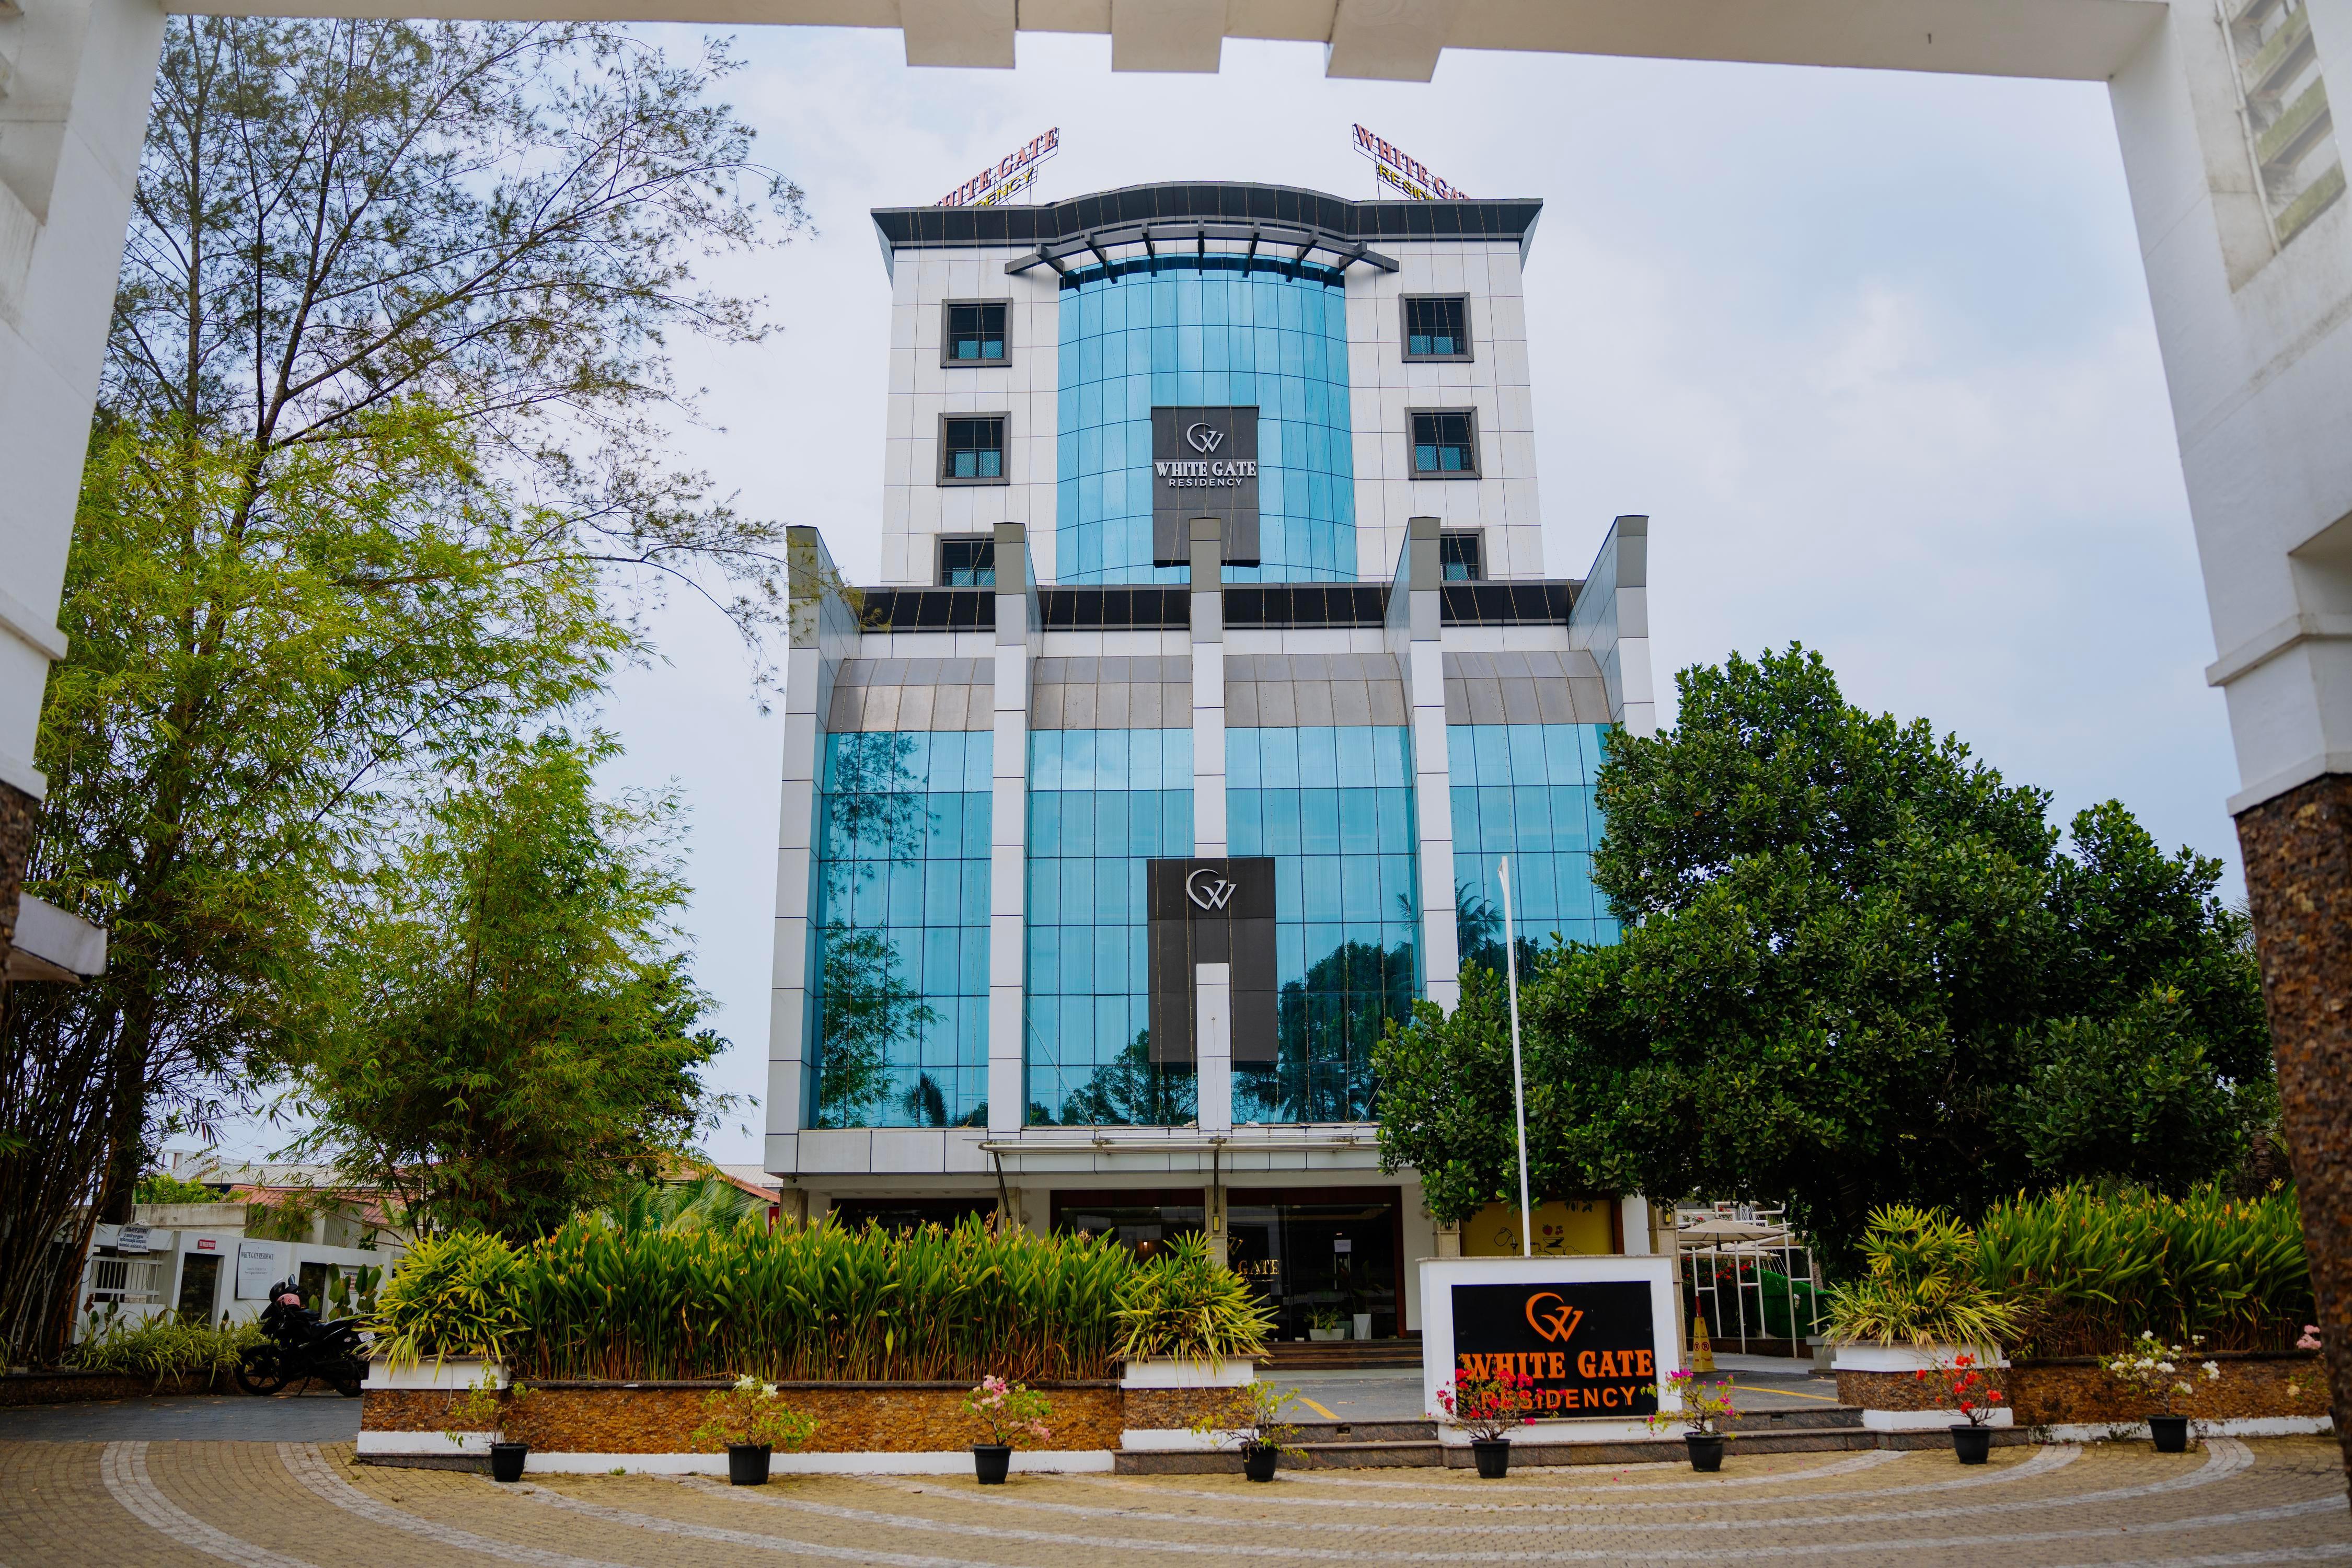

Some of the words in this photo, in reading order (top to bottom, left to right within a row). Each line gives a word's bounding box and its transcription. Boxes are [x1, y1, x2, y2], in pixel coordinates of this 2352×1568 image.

[998, 126, 1058, 178] GATE
[1354, 123, 1429, 187] WHITE
[1378, 164, 1435, 200] RESID
[1155, 462, 1208, 477] WHITE
[1212, 461, 1256, 477] GATE
[1169, 478, 1242, 487] RESIDENCY
[1238, 1259, 1279, 1274] GATE
[1462, 1352, 1566, 1380] WHITE
[1577, 1350, 1654, 1378] GATE
